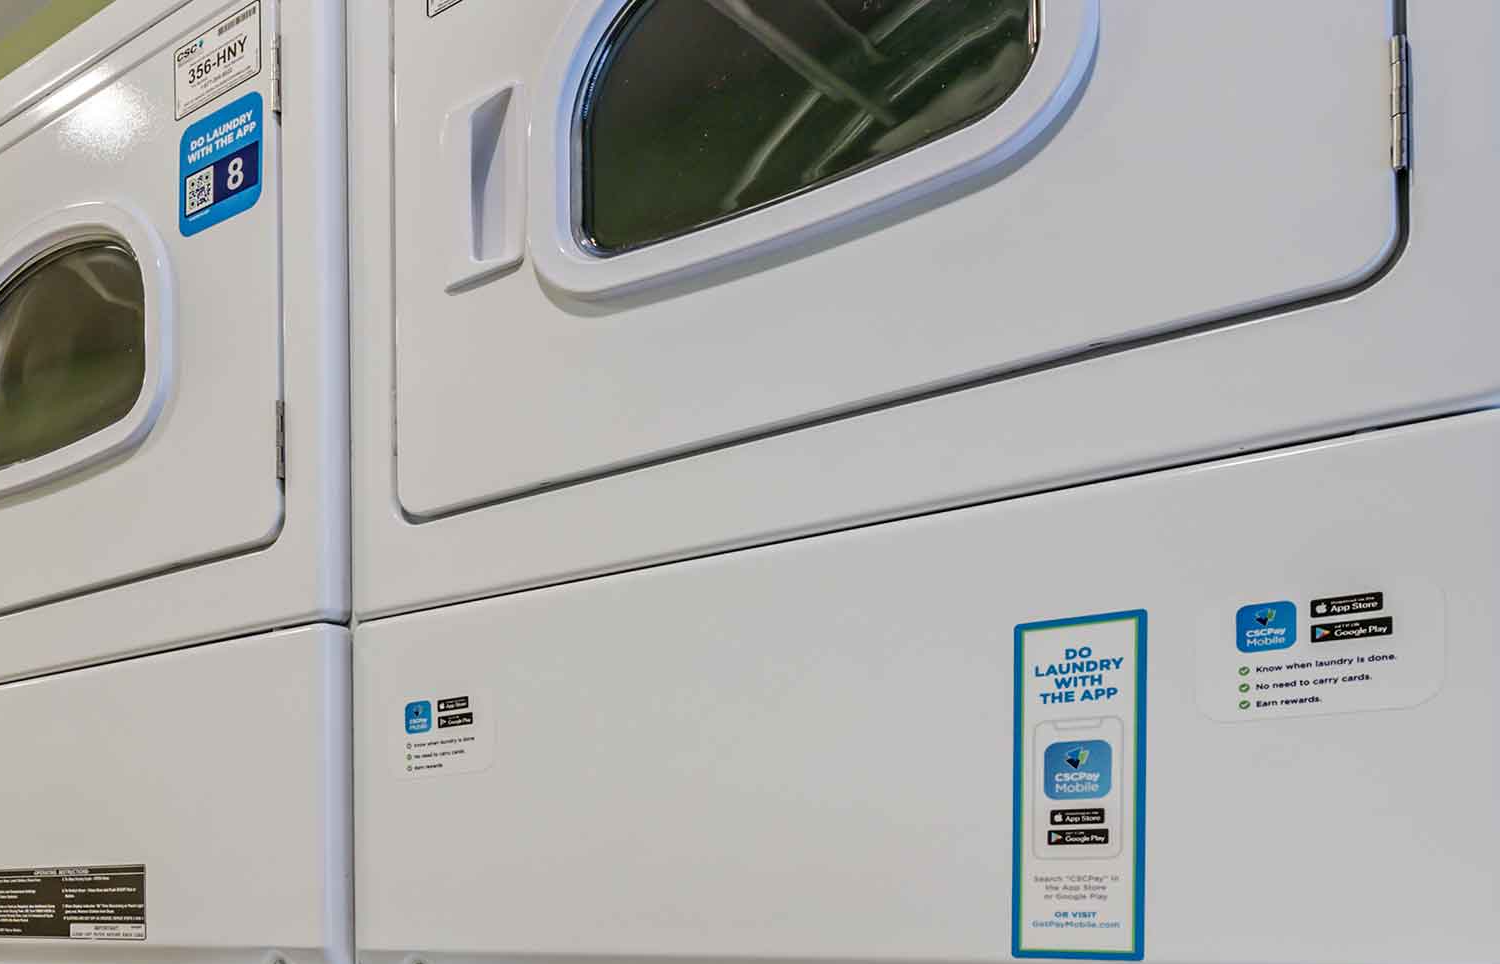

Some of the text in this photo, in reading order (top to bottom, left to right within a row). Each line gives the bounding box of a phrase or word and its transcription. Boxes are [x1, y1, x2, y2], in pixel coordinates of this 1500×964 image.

[177, 45, 198, 63] CSC
[188, 36, 247, 84] 356-HNY
[190, 110, 253, 151] DO LAUNDRY
[187, 121, 256, 164] WITH THE APP
[227, 156, 243, 191] 8
[1331, 602, 1378, 613] App Store
[1246, 627, 1286, 637] CSCPay
[1334, 625, 1387, 637] Google Play
[1246, 636, 1285, 646] Mobile
[1065, 647, 1092, 660] DO
[1035, 657, 1124, 677] LAUNDRY
[1256, 665, 1283, 673] Know
[1286, 662, 1312, 670] when
[1316, 657, 1353, 667] laundry
[1368, 654, 1396, 662] done.
[1054, 674, 1102, 689] WITH
[1273, 681, 1296, 689] need
[1313, 677, 1338, 685] carry
[1342, 674, 1372, 682] cards.
[1039, 688, 1118, 704] THE APP
[1281, 696, 1322, 705] rewards.
[1055, 772, 1100, 781] CSCPay
[1055, 782, 1099, 792] Mobile
